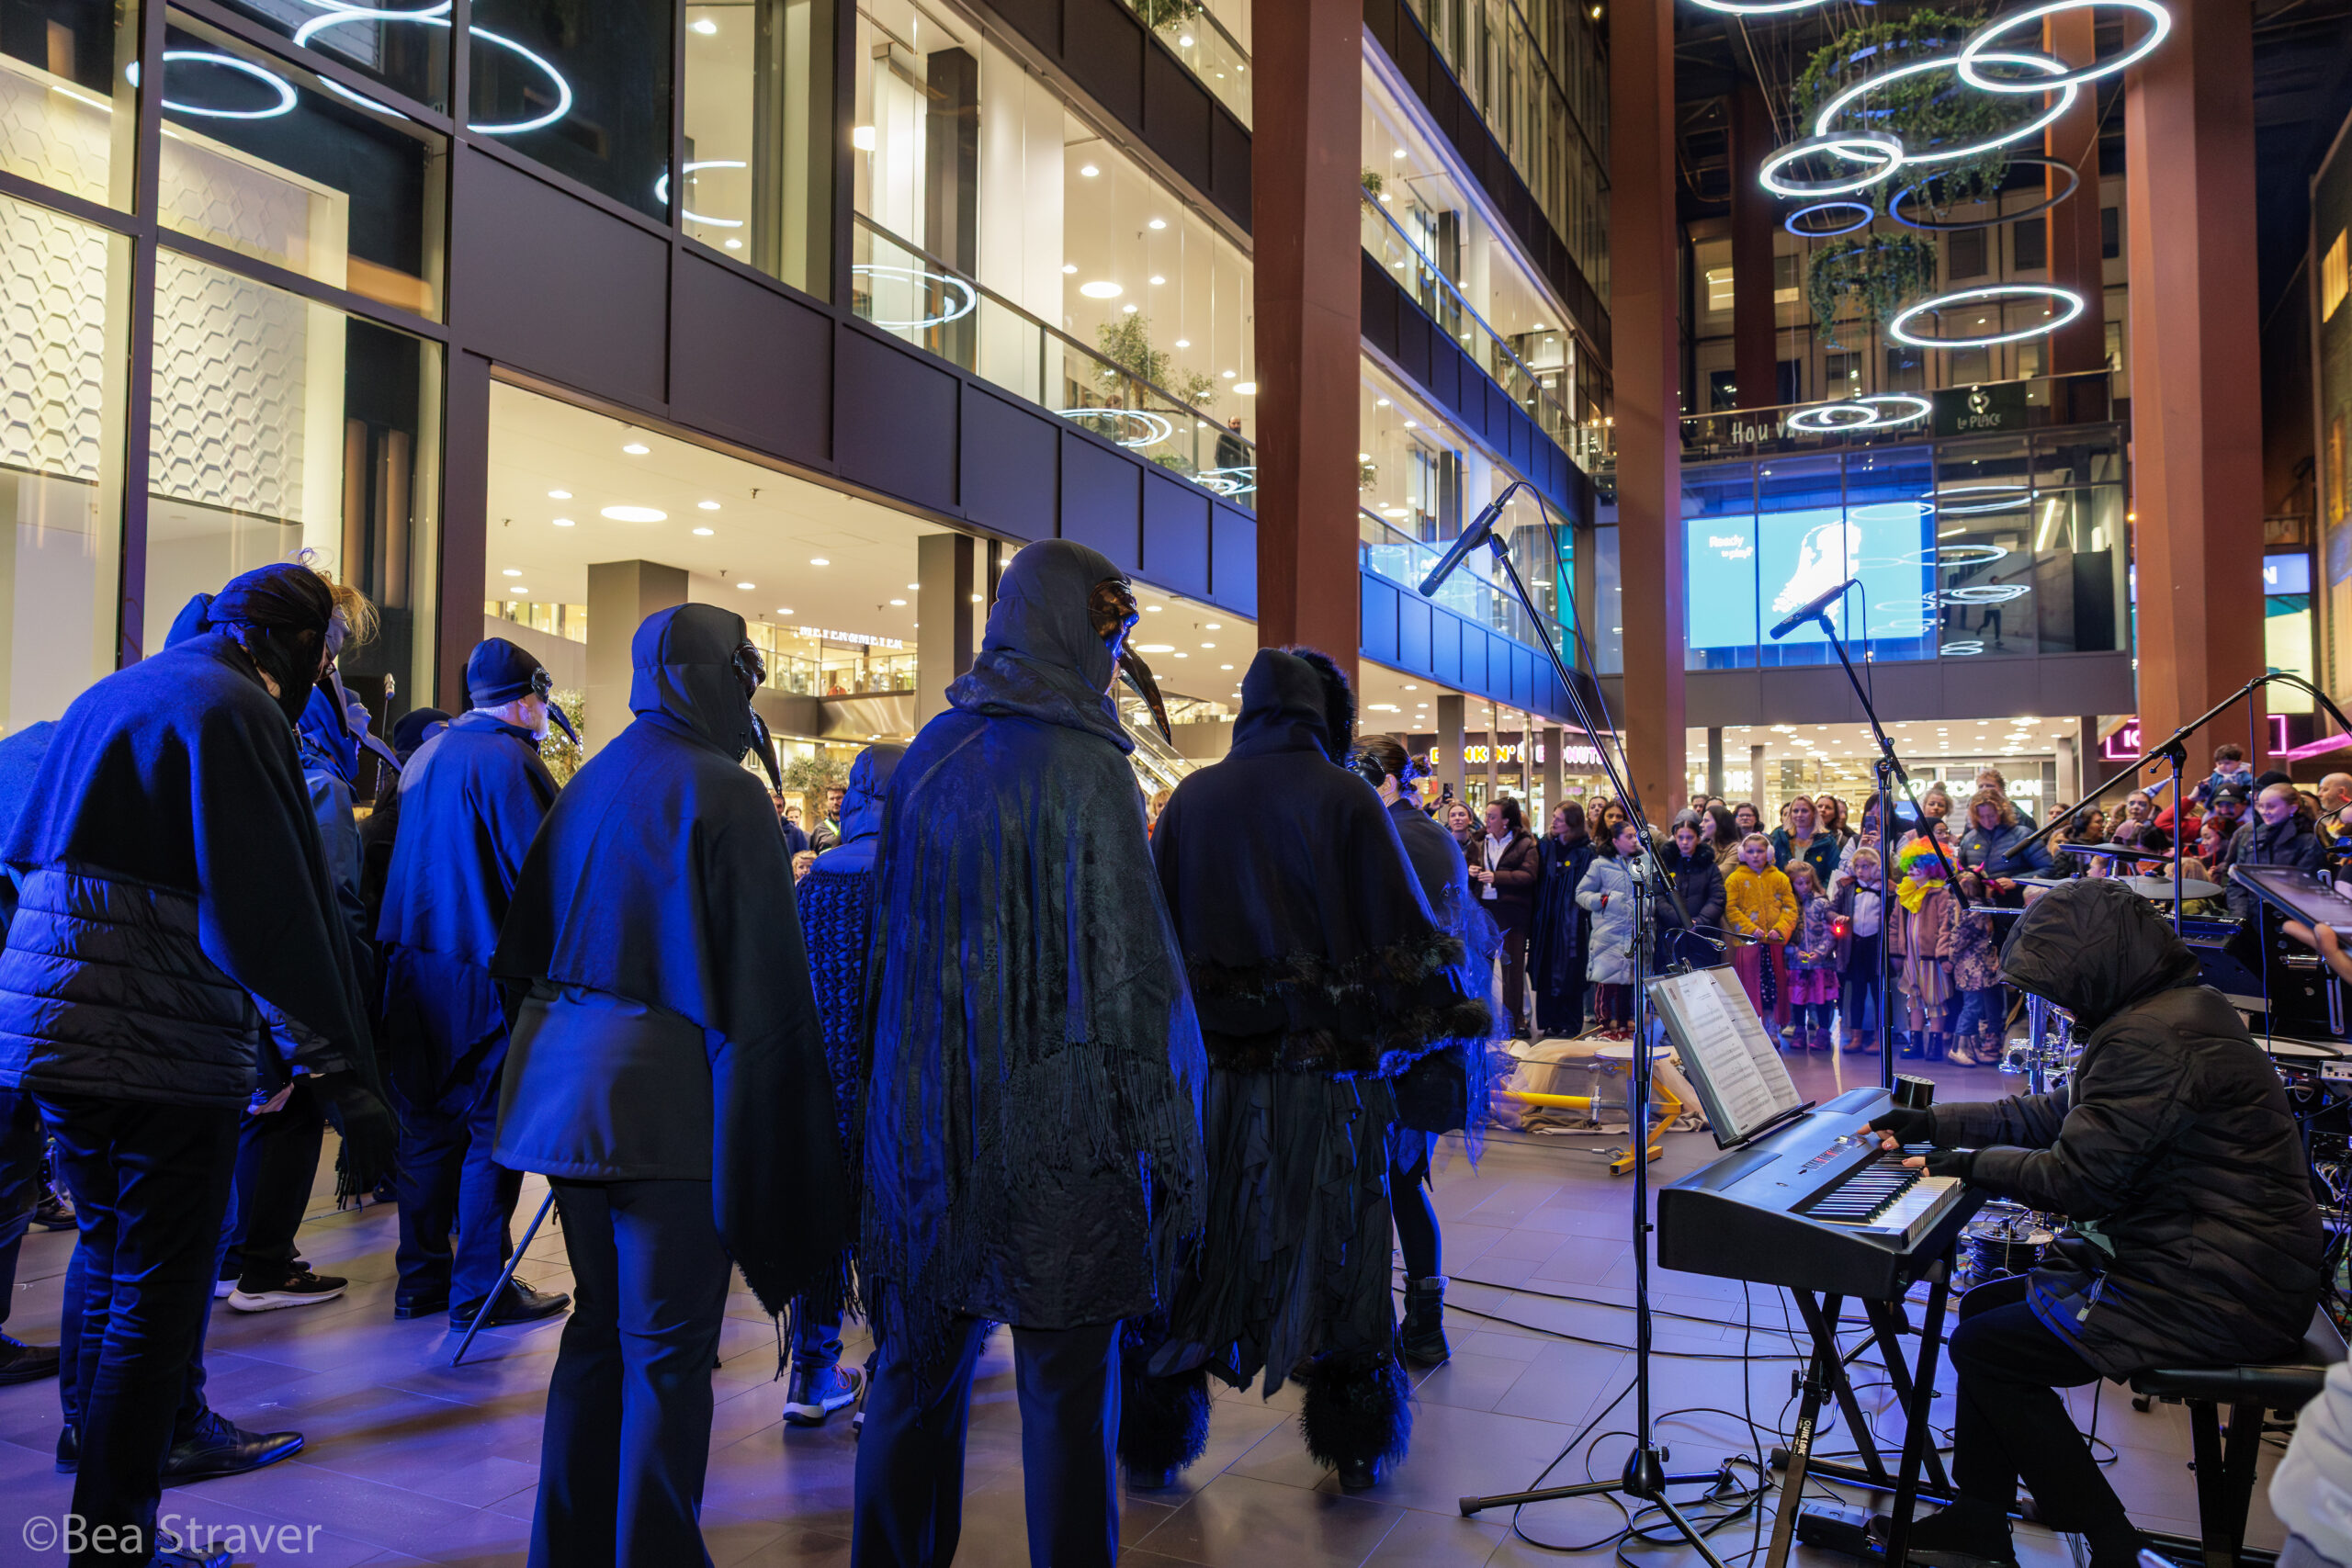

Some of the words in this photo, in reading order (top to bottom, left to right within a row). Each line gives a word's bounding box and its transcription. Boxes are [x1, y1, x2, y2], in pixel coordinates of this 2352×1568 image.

[1731, 422, 1769, 444] Hou
[1709, 535, 1744, 547] Ready
[1430, 745, 1517, 764] DNKN'
[1535, 745, 1604, 764] DNUT
